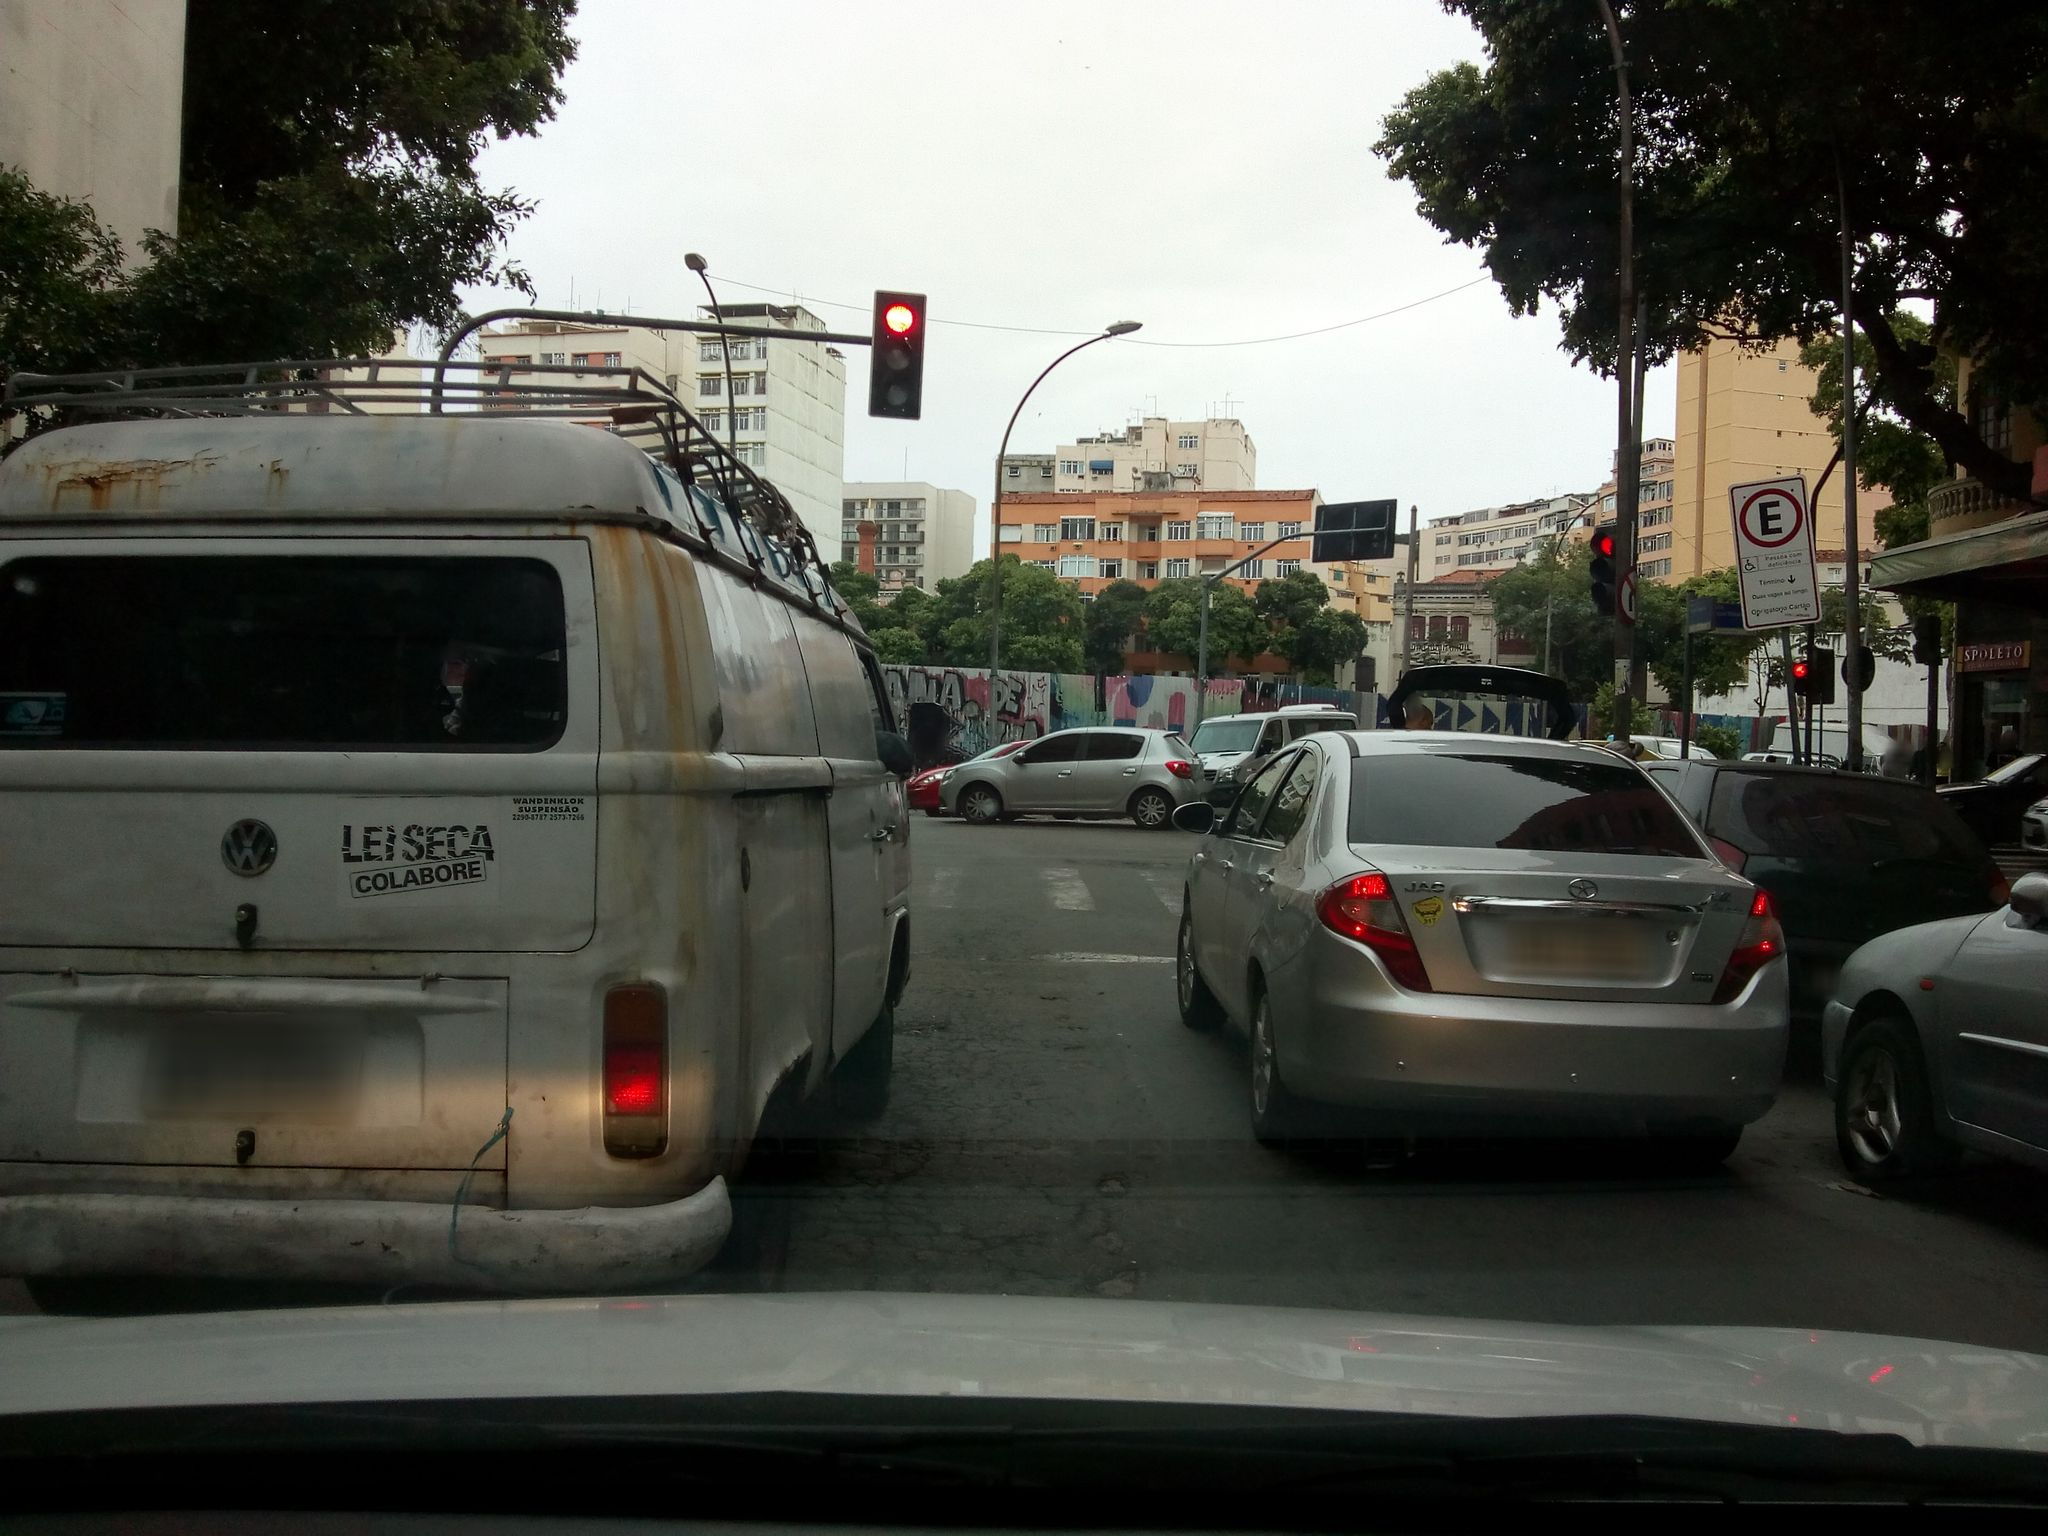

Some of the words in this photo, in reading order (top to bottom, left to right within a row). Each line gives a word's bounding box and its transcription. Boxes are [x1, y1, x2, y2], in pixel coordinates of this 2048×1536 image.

[1758, 500, 1783, 536] E
[1964, 645, 2023, 662] SPOLETO
[518, 805, 579, 813] SUSPENSÃO
[341, 824, 397, 863] LEI
[401, 824, 495, 862] SECA
[354, 861, 482, 893] COLABORE
[1404, 880, 1445, 893] JAC
